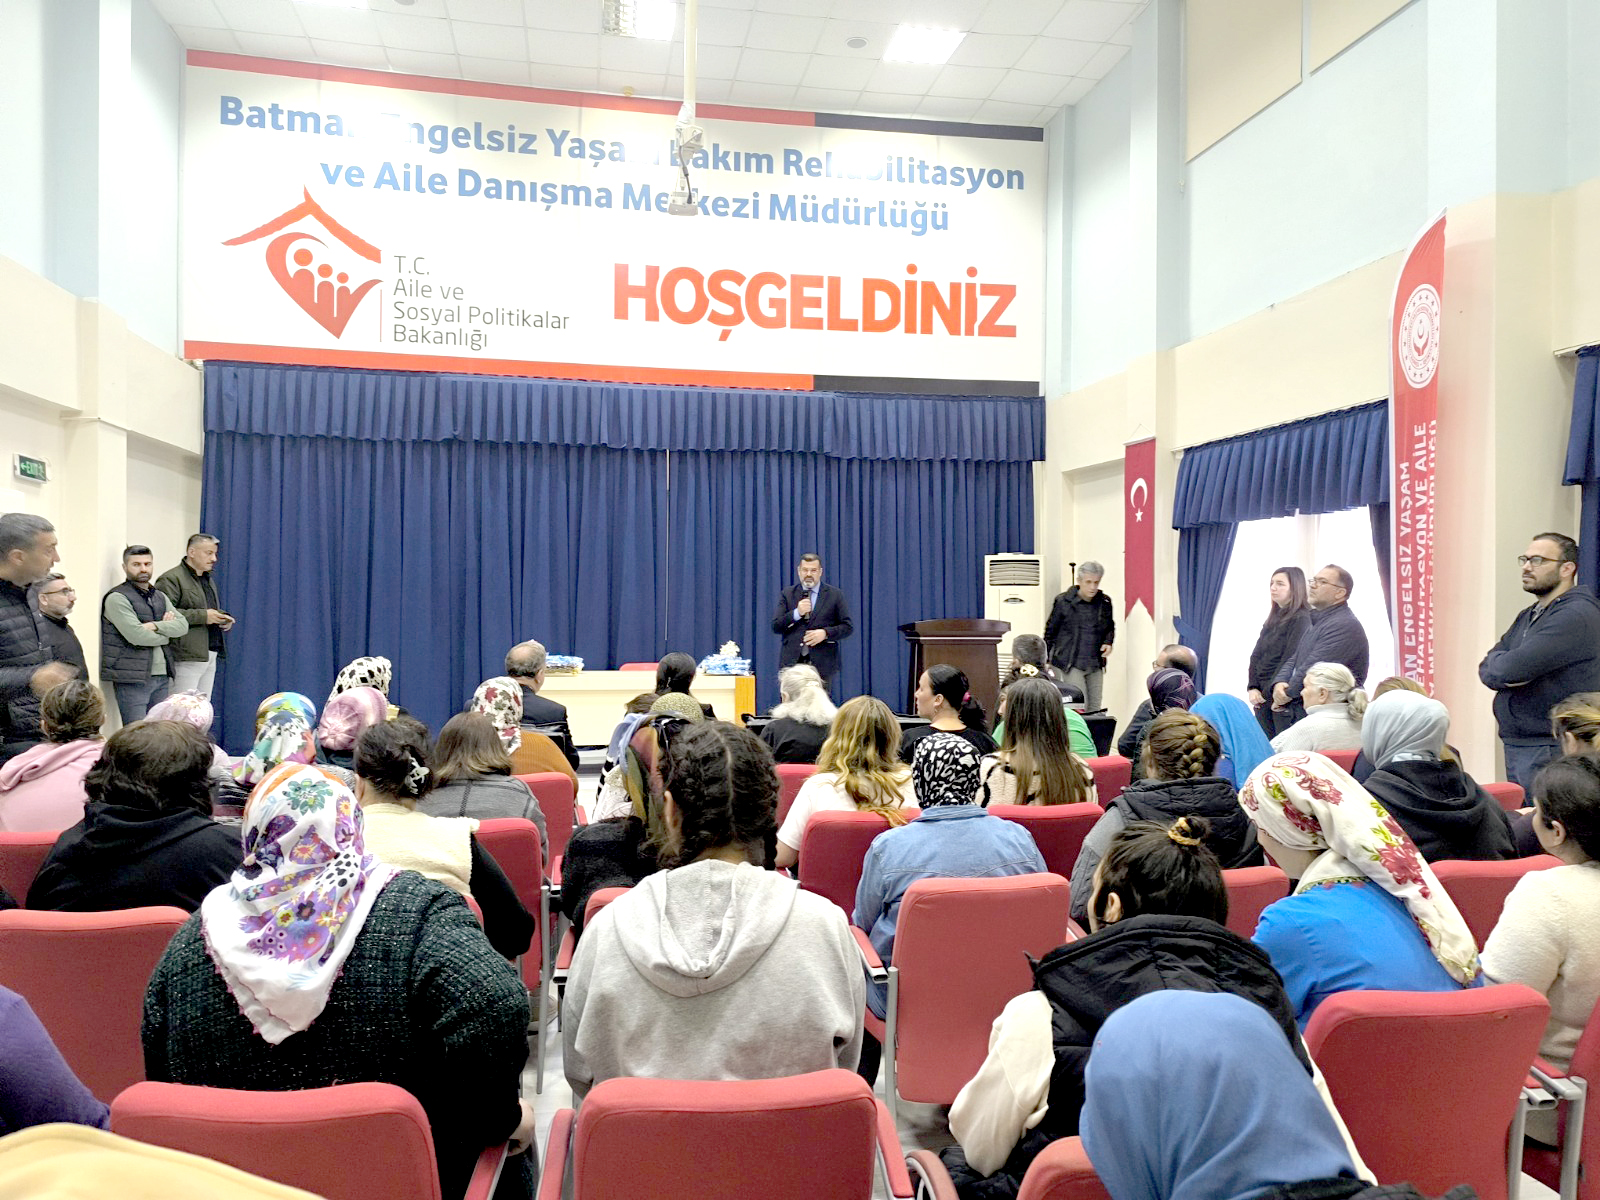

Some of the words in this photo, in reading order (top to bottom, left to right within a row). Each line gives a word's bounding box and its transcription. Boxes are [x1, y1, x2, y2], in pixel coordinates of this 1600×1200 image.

[381, 113, 538, 155] ngelsiz
[545, 128, 660, 168] Yaşa
[320, 162, 365, 188] ve
[373, 161, 449, 195] Aile
[458, 168, 612, 212] Danışma
[622, 182, 760, 219] Mekezi
[769, 193, 949, 237] Müdürlüğü
[393, 255, 430, 276] T.C.
[393, 268, 432, 298] Aile
[439, 285, 464, 301] ve
[393, 301, 461, 326] Sosyal
[468, 305, 570, 330] Politikalar
[614, 263, 1017, 342] HOŞGELDİNİZ
[393, 323, 488, 352] Bakanlığı
[1412, 422, 1427, 472] AİLE
[1399, 461, 1413, 537] YAŞAM
[1414, 478, 1427, 508] VE
[1398, 543, 1417, 646] ENGELSİZ
